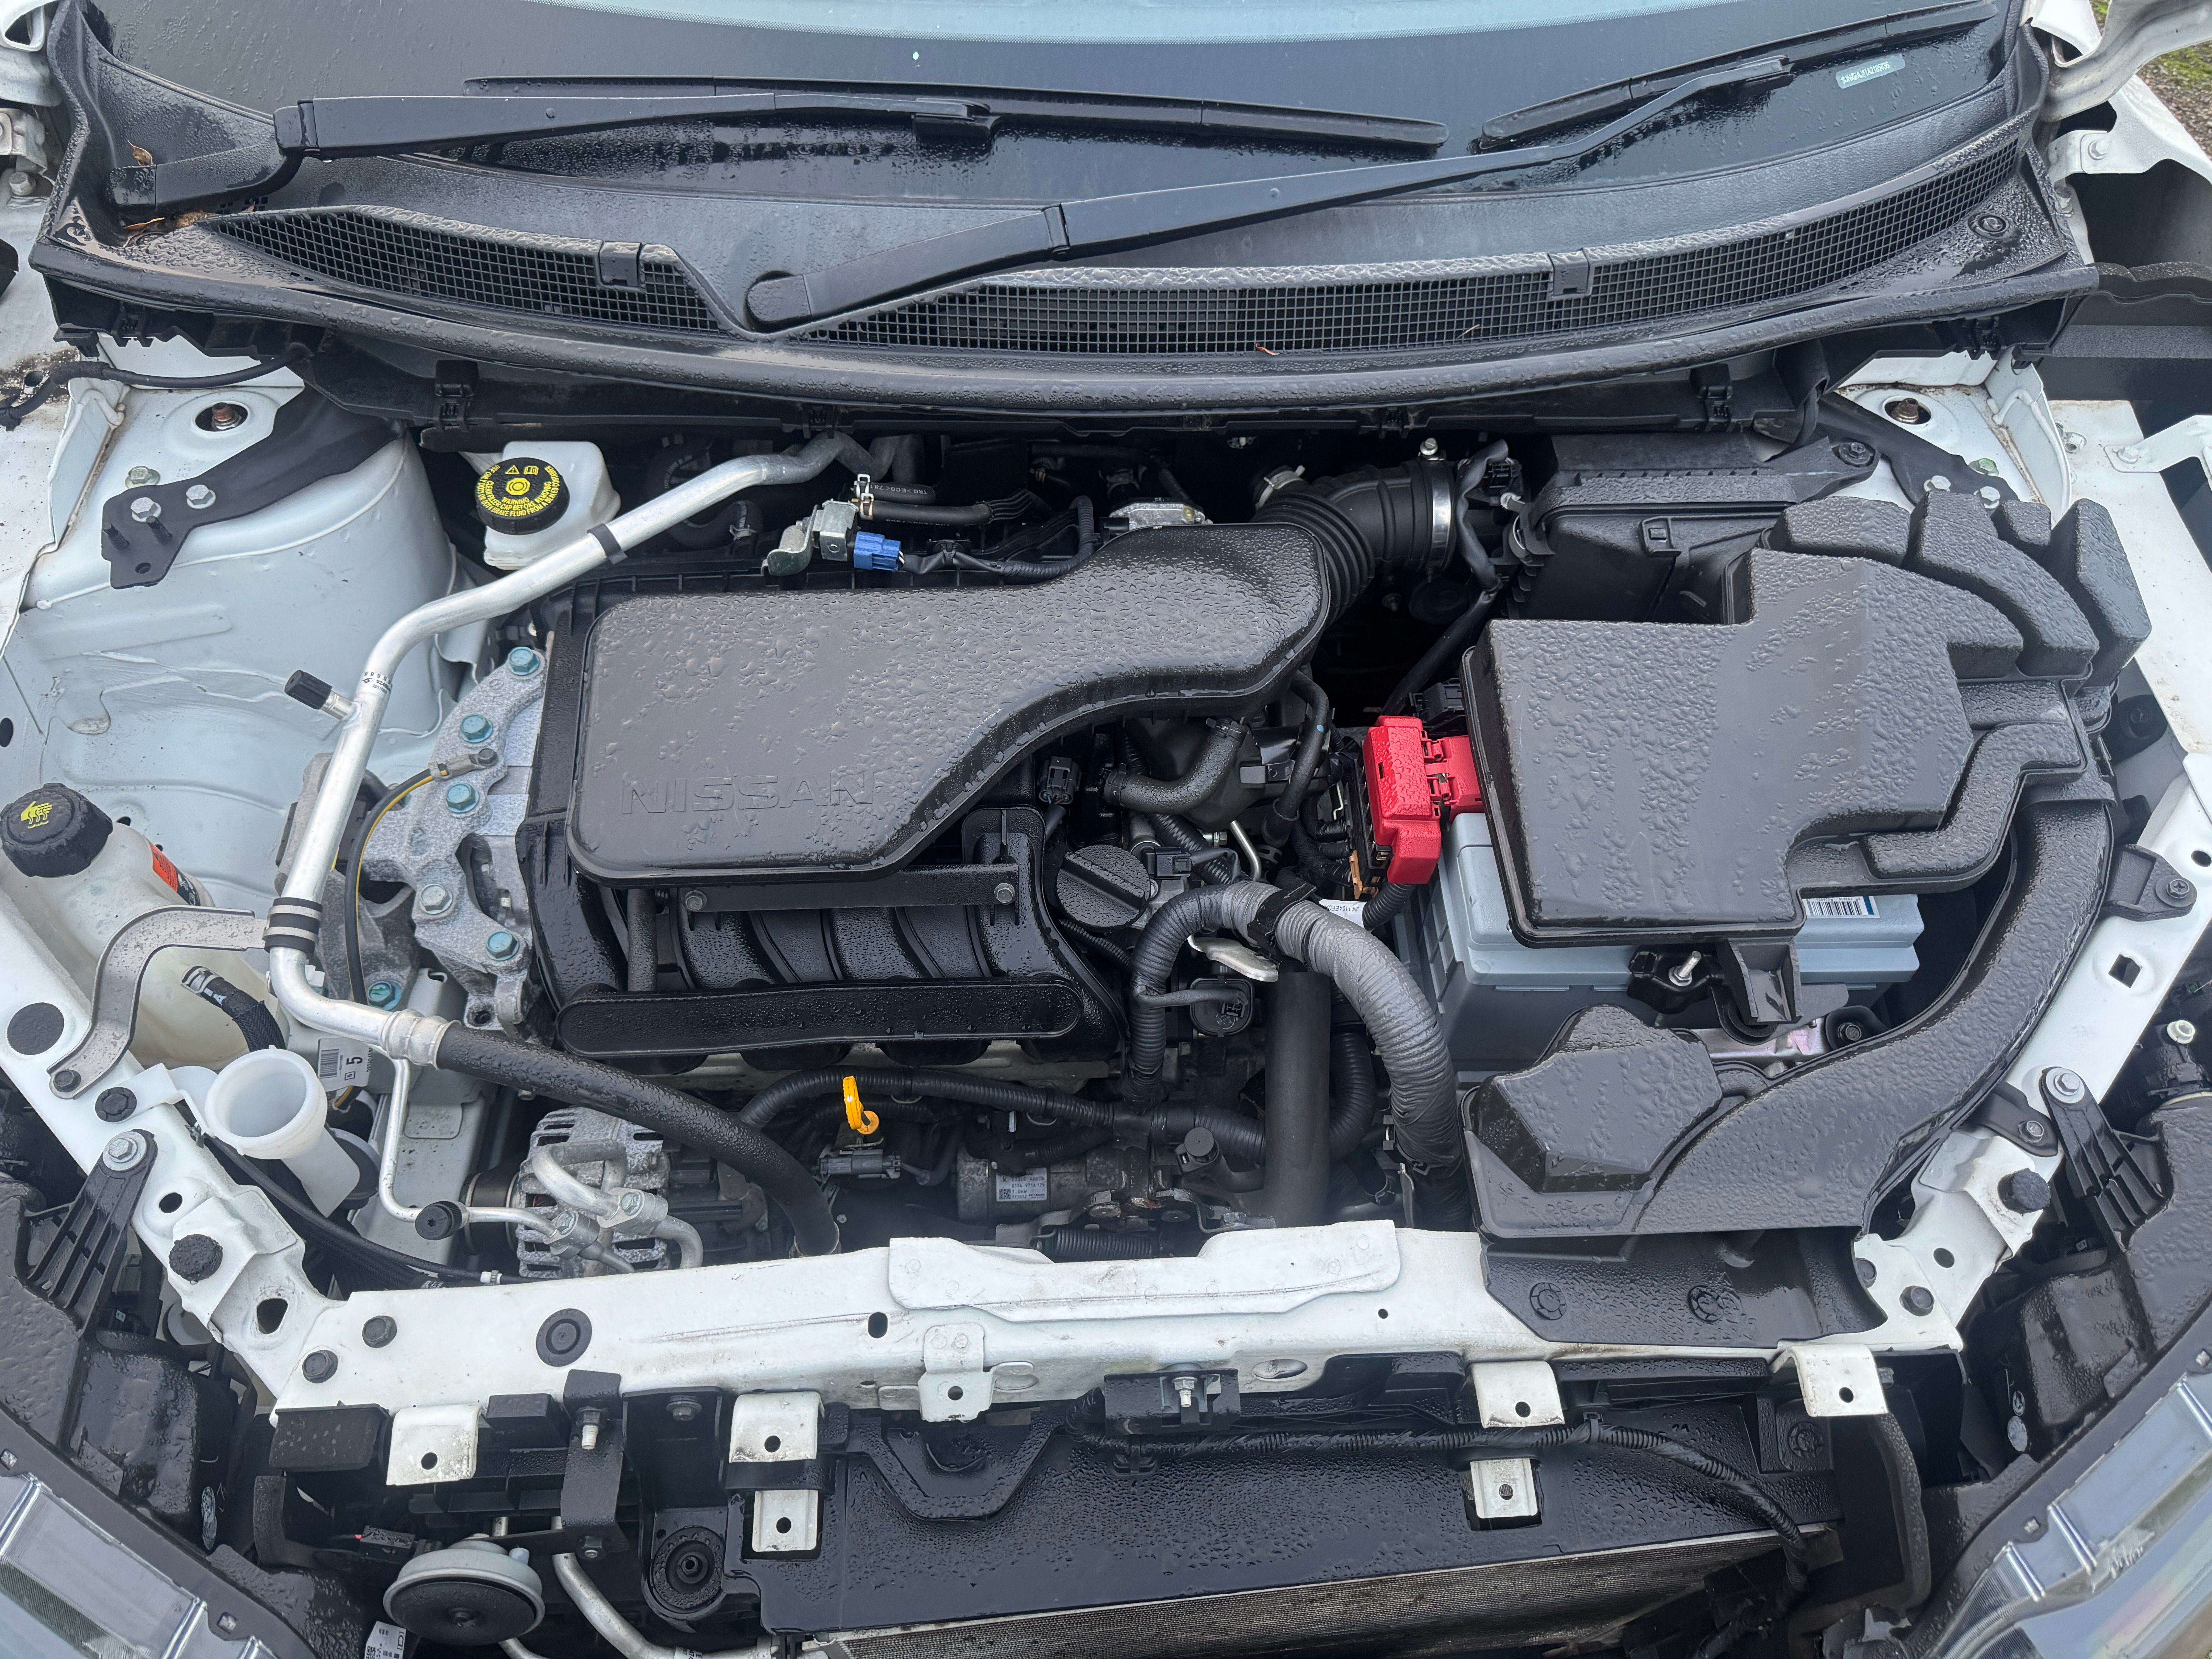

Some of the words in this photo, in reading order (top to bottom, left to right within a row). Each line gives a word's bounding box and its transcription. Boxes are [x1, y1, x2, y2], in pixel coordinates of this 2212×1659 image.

[488, 465, 501, 473] USE
[480, 472, 492, 483] ONLY
[544, 465, 560, 487] CONTAINER
[485, 481, 495, 495] CLEAN
[534, 481, 551, 503] REMOVING
[486, 494, 502, 507] FILLER
[544, 488, 559, 503] SEALED
[491, 507, 509, 516] BRAKE
[513, 501, 537, 511] BEFORE
[527, 504, 544, 514] FROM
[622, 771, 874, 815] NISSAN
[346, 1056, 363, 1065] 5
